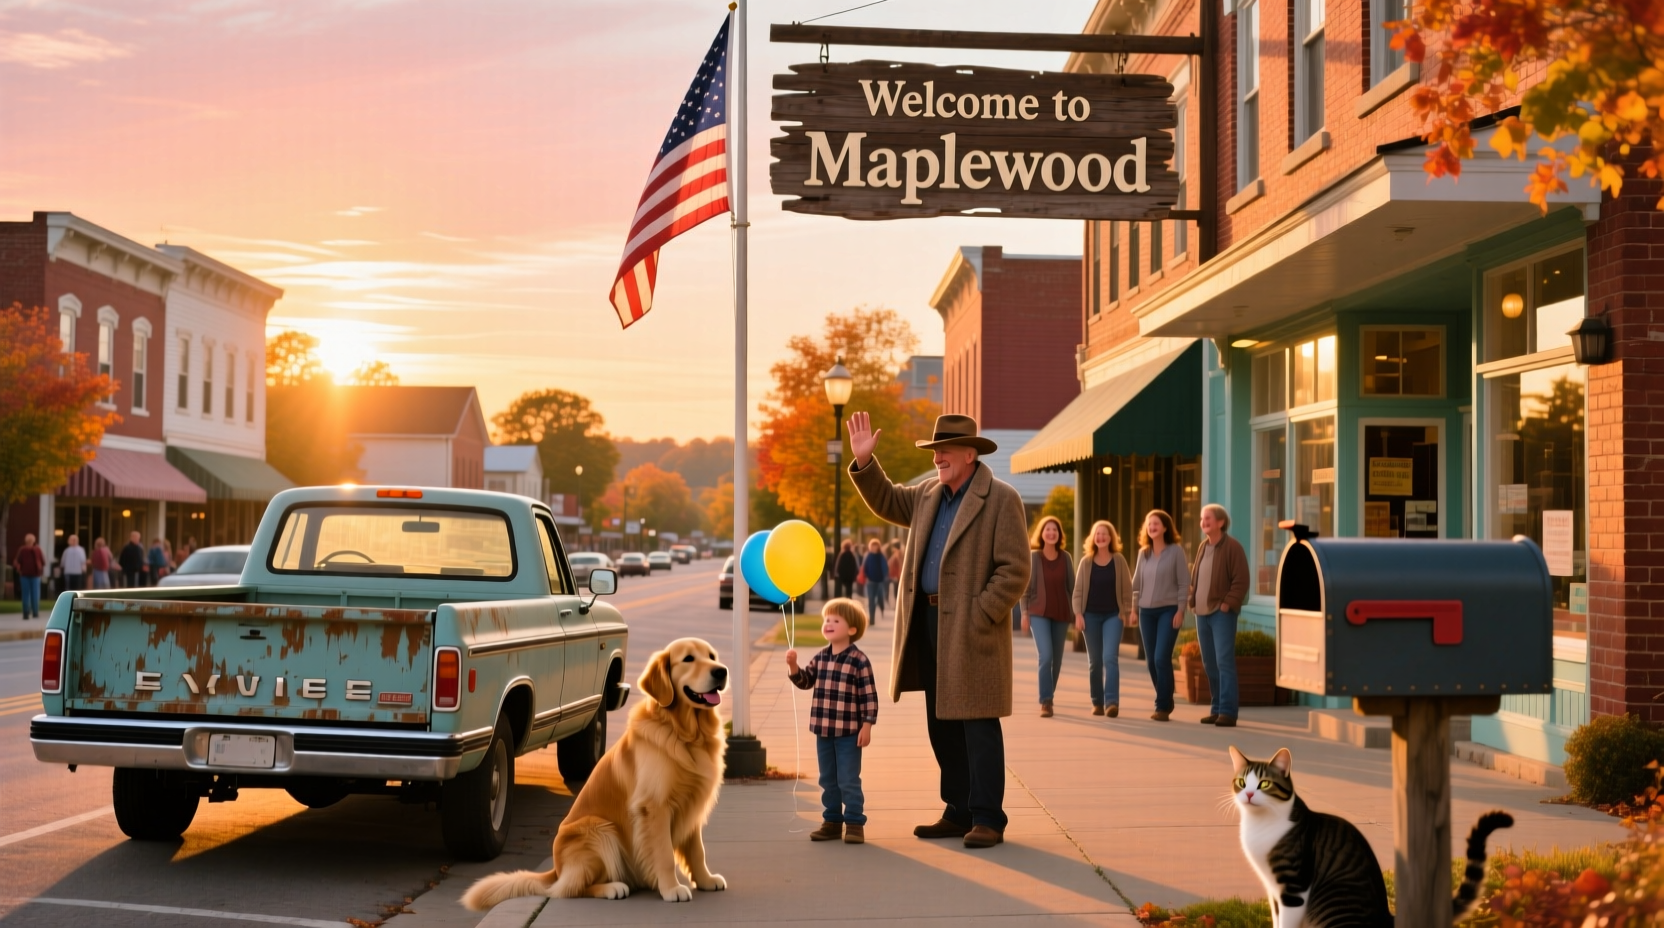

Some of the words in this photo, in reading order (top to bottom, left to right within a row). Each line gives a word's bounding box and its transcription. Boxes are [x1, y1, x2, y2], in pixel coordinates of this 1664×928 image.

[858, 79, 1040, 120] Welcome
[1051, 90, 1091, 122] to
[803, 131, 1151, 205] Maplewood
